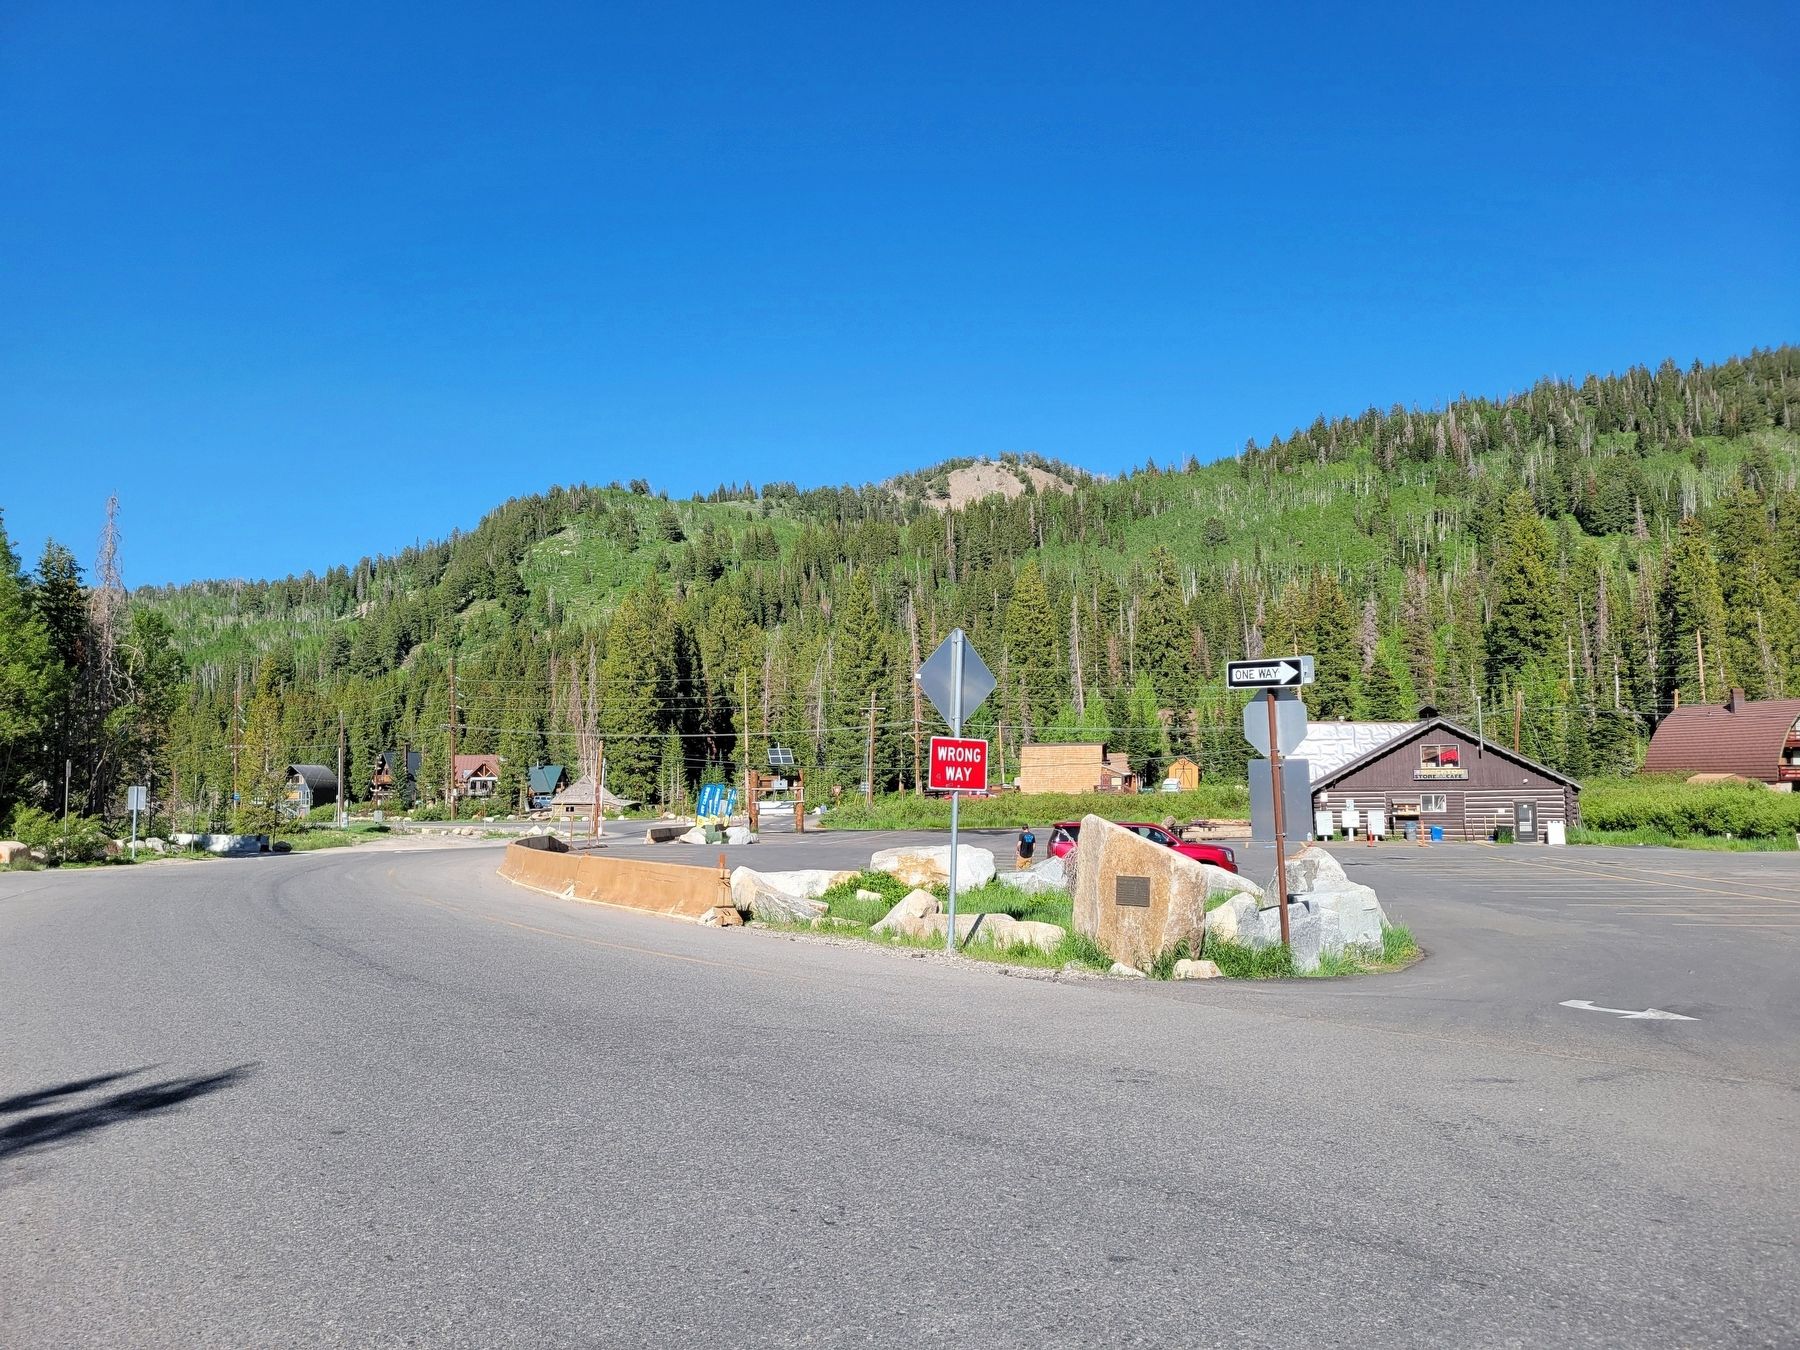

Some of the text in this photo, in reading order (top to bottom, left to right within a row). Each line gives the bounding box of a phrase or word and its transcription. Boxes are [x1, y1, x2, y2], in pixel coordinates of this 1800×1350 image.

[1235, 668, 1279, 680] ONE WAY
[937, 746, 981, 763] WRONG
[945, 766, 972, 781] WAY
